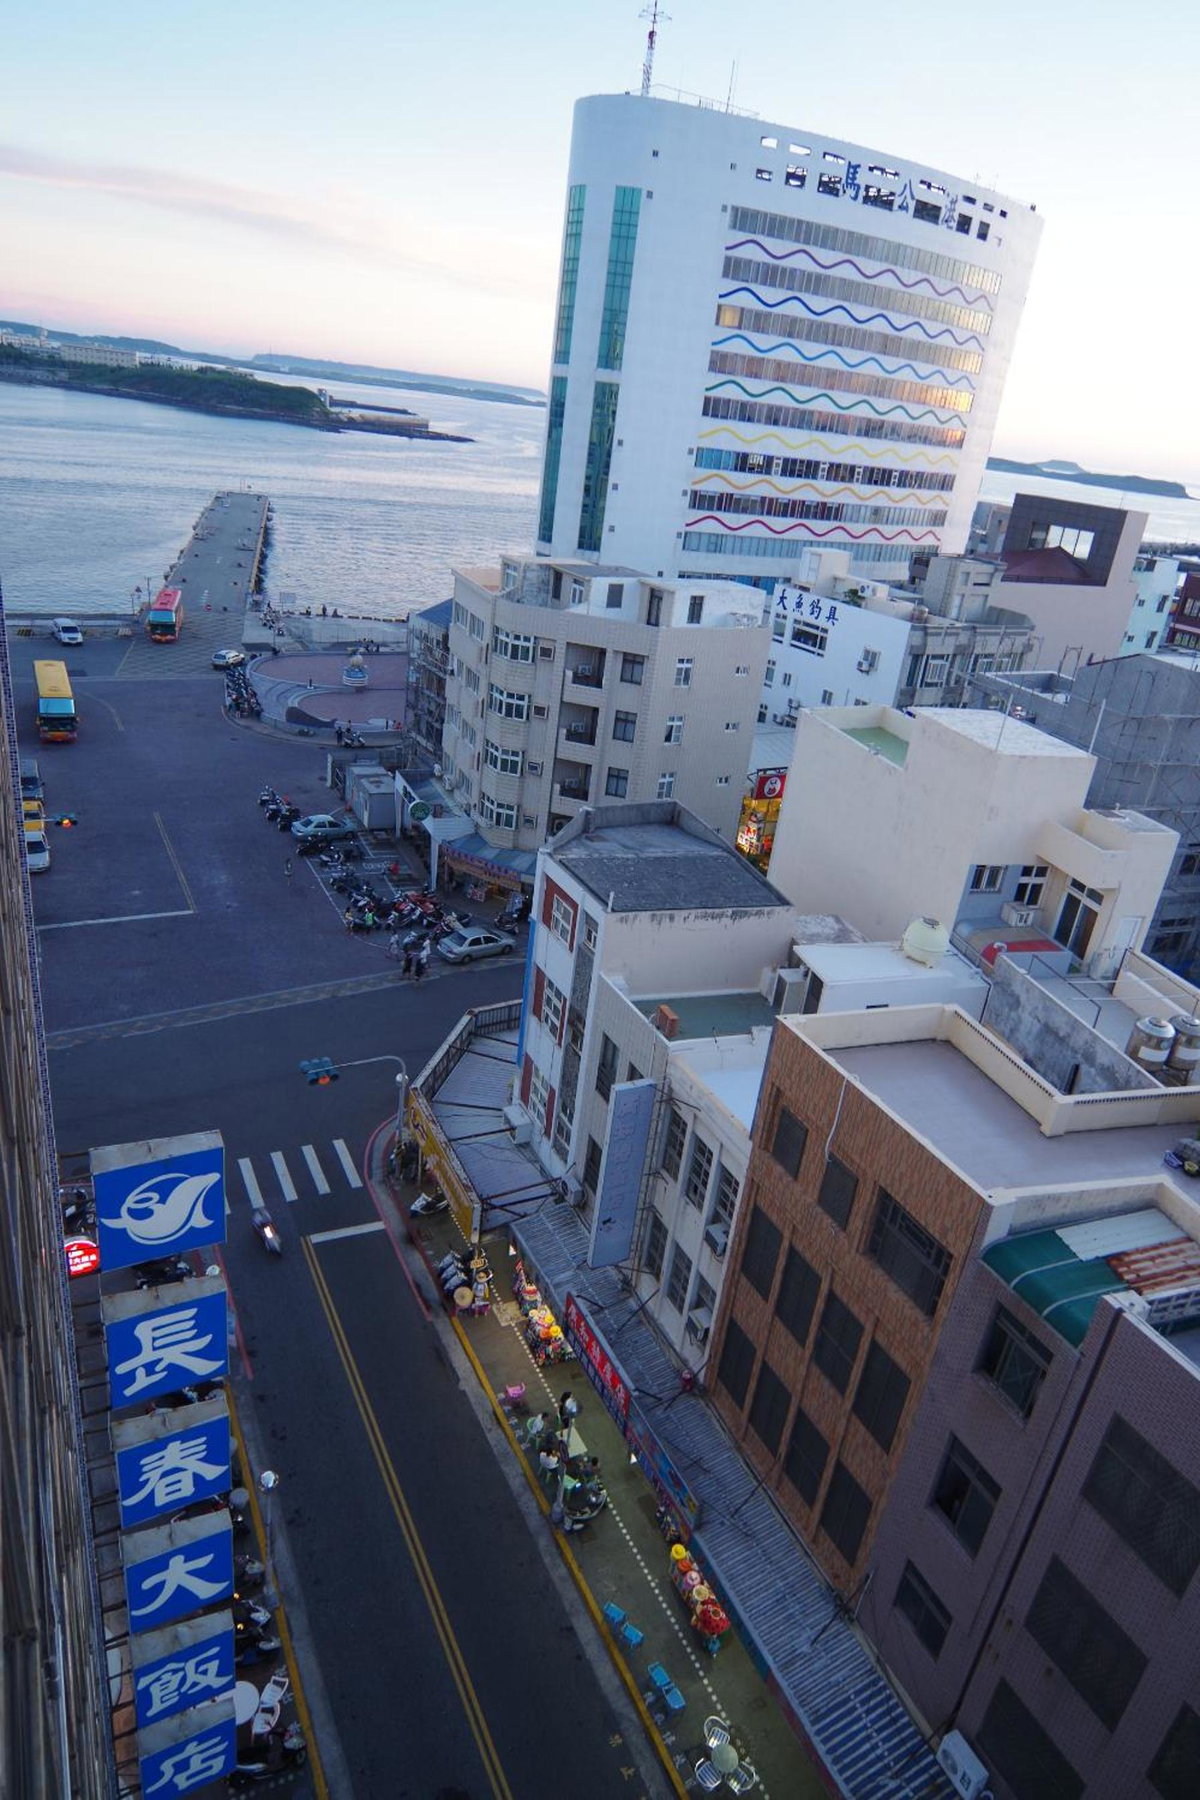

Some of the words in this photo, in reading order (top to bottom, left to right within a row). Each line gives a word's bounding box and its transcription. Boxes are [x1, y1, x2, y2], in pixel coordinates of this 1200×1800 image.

[776, 588, 839, 626] 大魚釣具
[114, 1307, 233, 1794] 長春大飯店
